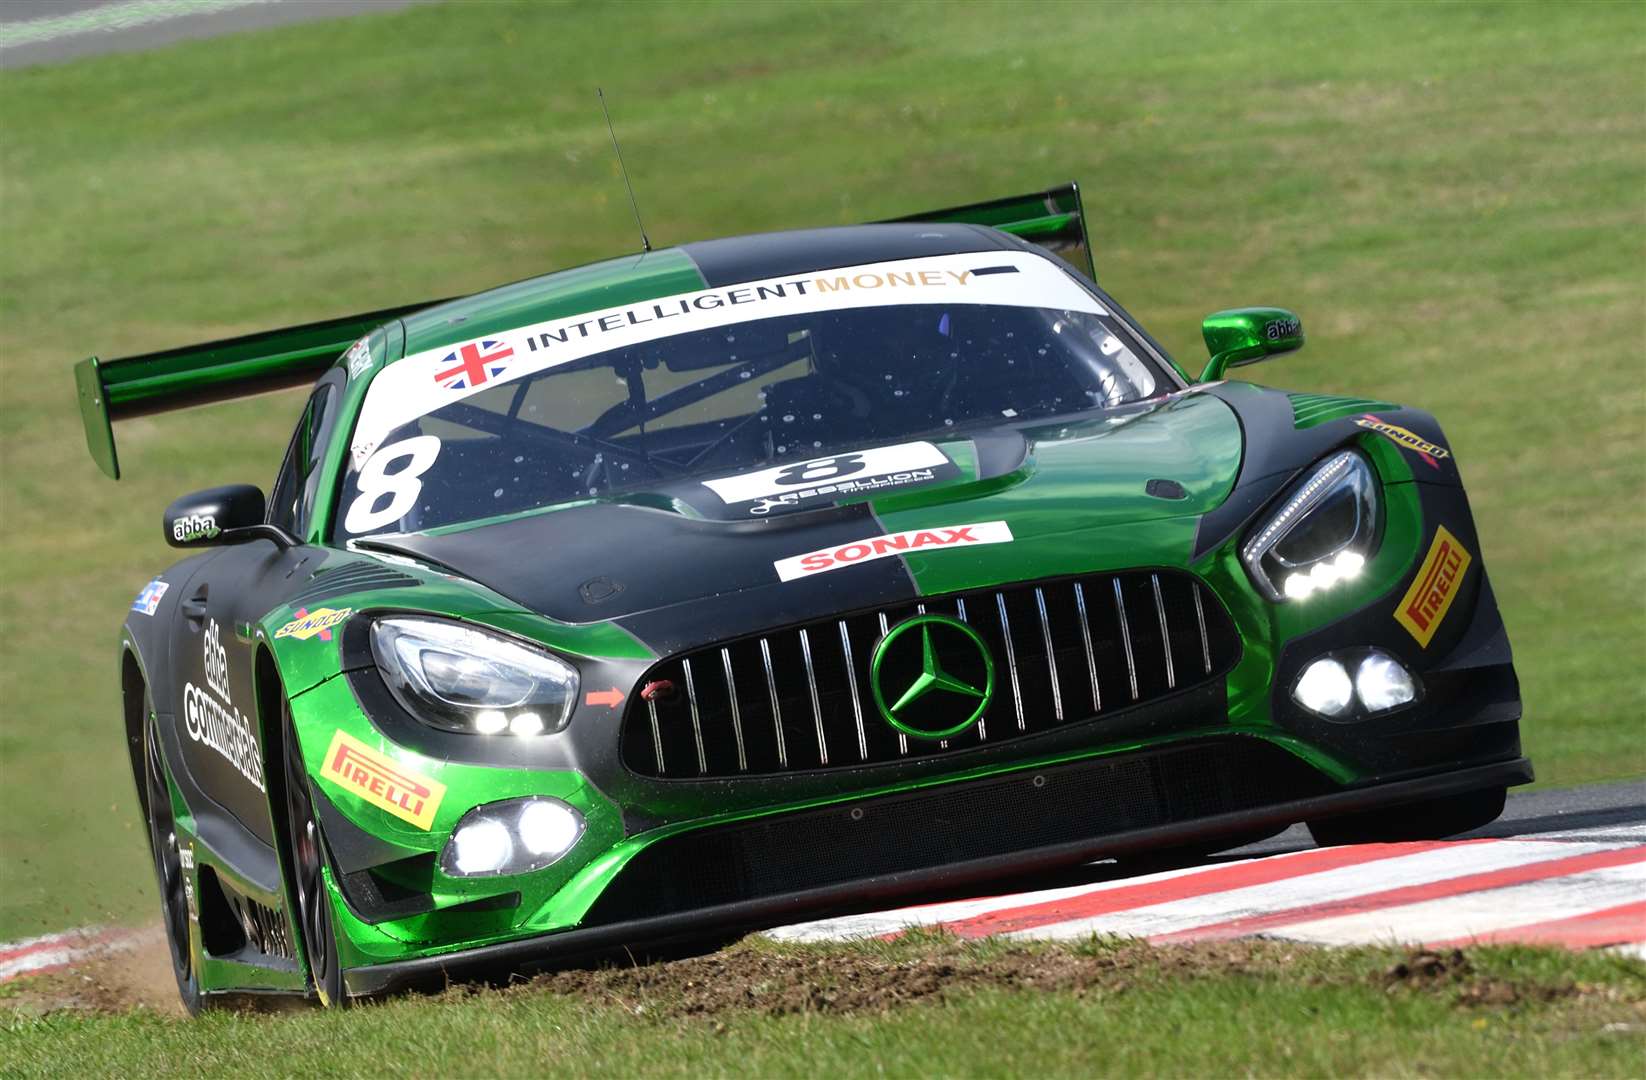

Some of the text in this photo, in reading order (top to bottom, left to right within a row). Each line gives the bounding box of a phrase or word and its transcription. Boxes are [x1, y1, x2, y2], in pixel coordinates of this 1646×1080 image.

[344, 435, 442, 534] 8
[775, 454, 866, 486] 8
[779, 468, 933, 502] REBELLION
[175, 515, 215, 540] abba
[800, 527, 979, 572] SONAX
[1406, 539, 1463, 633] PIRELLI
[277, 610, 349, 635] SUNOCO
[331, 743, 431, 817] PIRELLI
